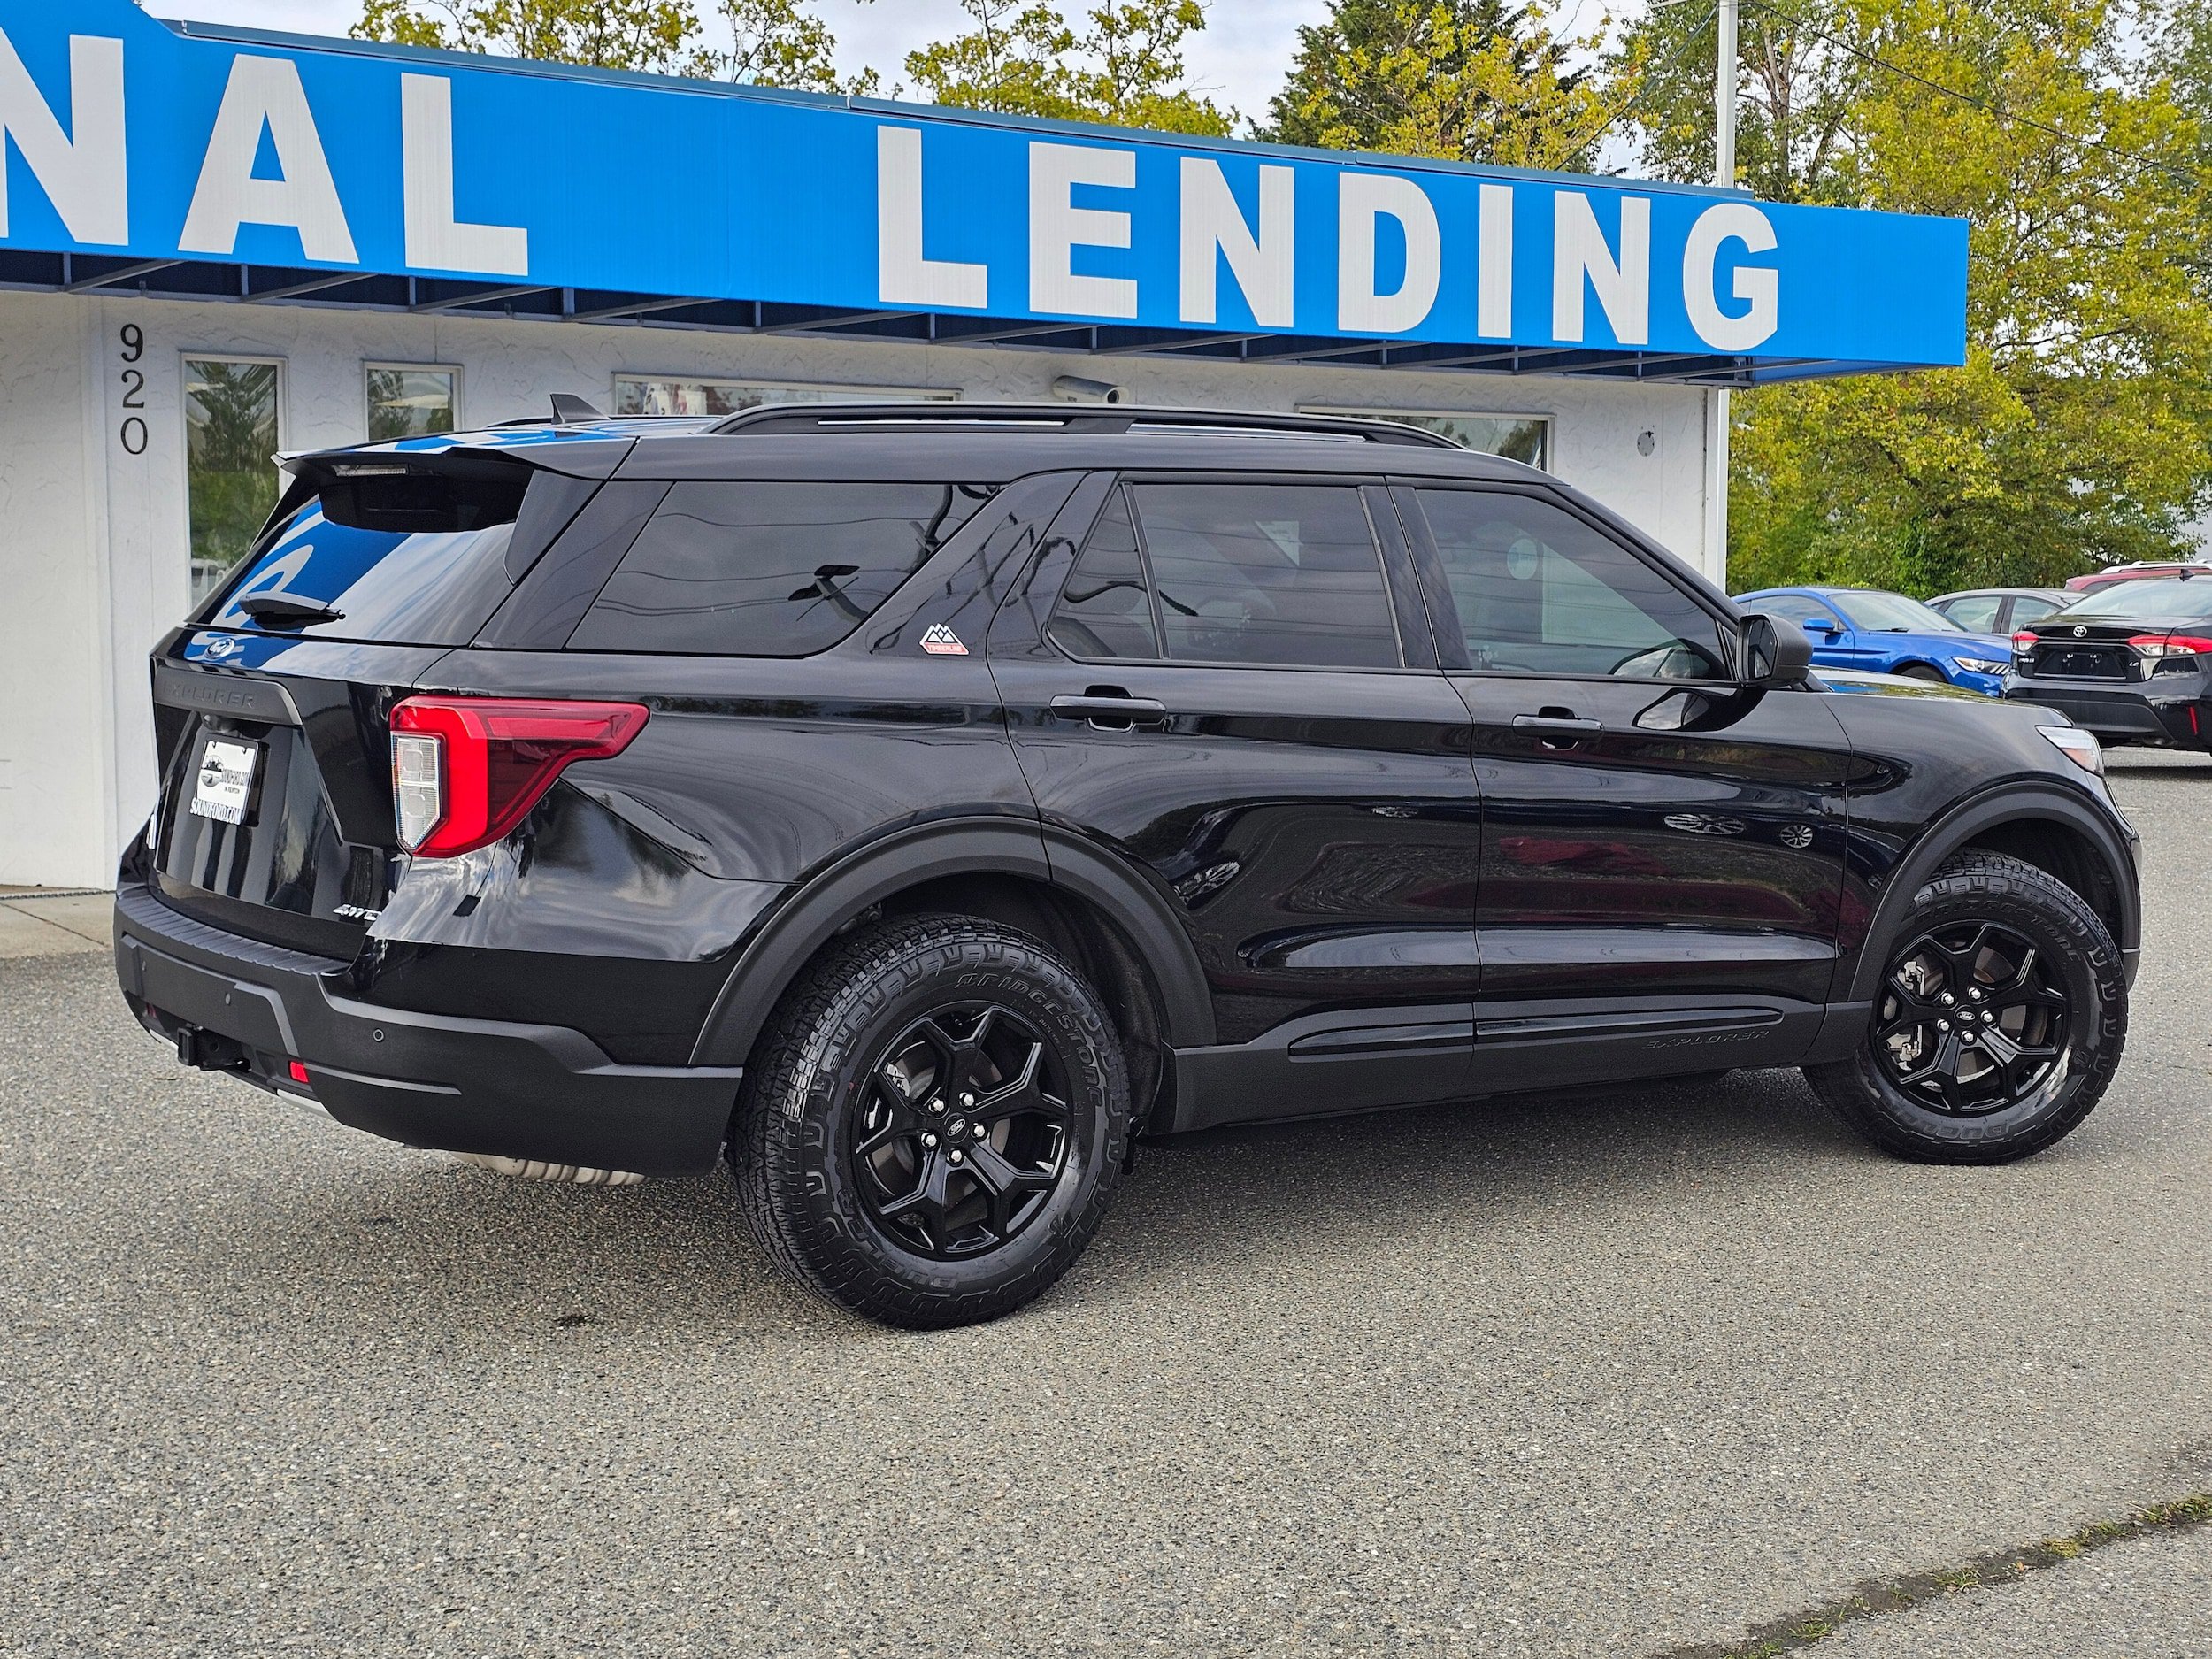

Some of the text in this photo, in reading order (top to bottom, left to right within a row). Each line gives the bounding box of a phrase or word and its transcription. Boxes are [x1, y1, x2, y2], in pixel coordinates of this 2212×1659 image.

[0, 25, 1779, 352] NAL LENDING
[119, 324, 148, 455] 920
[163, 680, 257, 708] EXPLORER
[189, 797, 242, 826] SOUNDFORD.COM
[954, 972, 1103, 1106] BRIDGESTONE
[1642, 1030, 1770, 1049] EXPLORER
